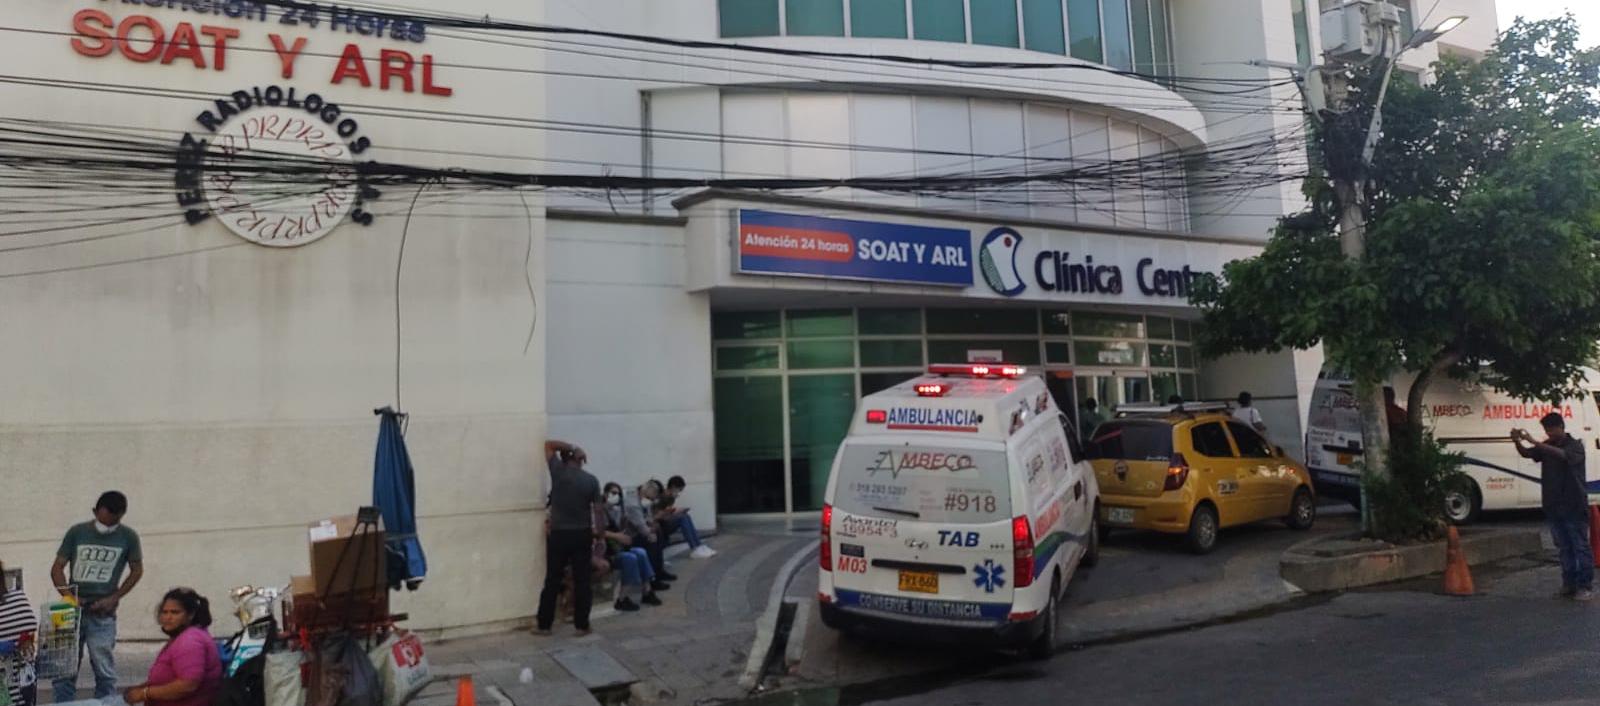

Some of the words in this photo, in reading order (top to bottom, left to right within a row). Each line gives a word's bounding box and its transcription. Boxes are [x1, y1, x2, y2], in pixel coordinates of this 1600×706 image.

[71, 9, 240, 71] SOAT
[268, 33, 308, 79] Y
[331, 43, 453, 97] ARL
[196, 85, 372, 155] RADIOLOGOS
[745, 232, 798, 249] Atención
[801, 237, 816, 251] 24
[818, 239, 849, 253] horas
[858, 238, 909, 264] SOAT
[909, 243, 926, 264] Y
[931, 245, 967, 267] ARL
[1034, 250, 1123, 295] Clínica
[888, 408, 978, 426] AMBULANCIA
[944, 493, 997, 514] #918
[938, 530, 980, 548] TAB
[859, 593, 909, 613] CONSERVE
[927, 600, 982, 618] DISTANCIA
